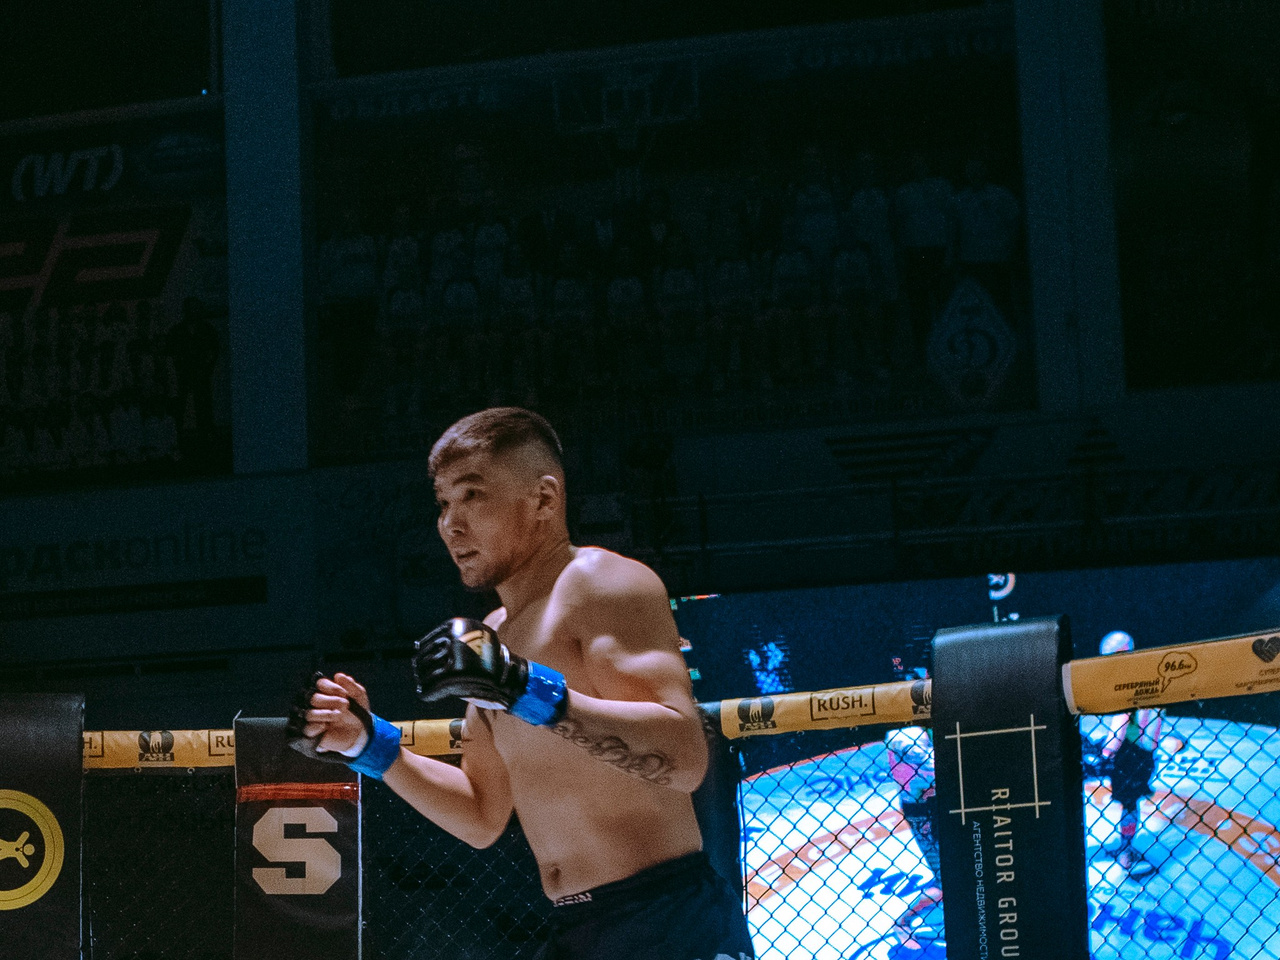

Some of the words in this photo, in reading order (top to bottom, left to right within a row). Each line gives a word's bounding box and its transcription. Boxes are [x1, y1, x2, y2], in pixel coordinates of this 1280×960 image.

[11, 144, 124, 202] (WT)
[817, 695, 868, 712] RUSH.
[972, 820, 985, 877] АГЕНТСТВО
